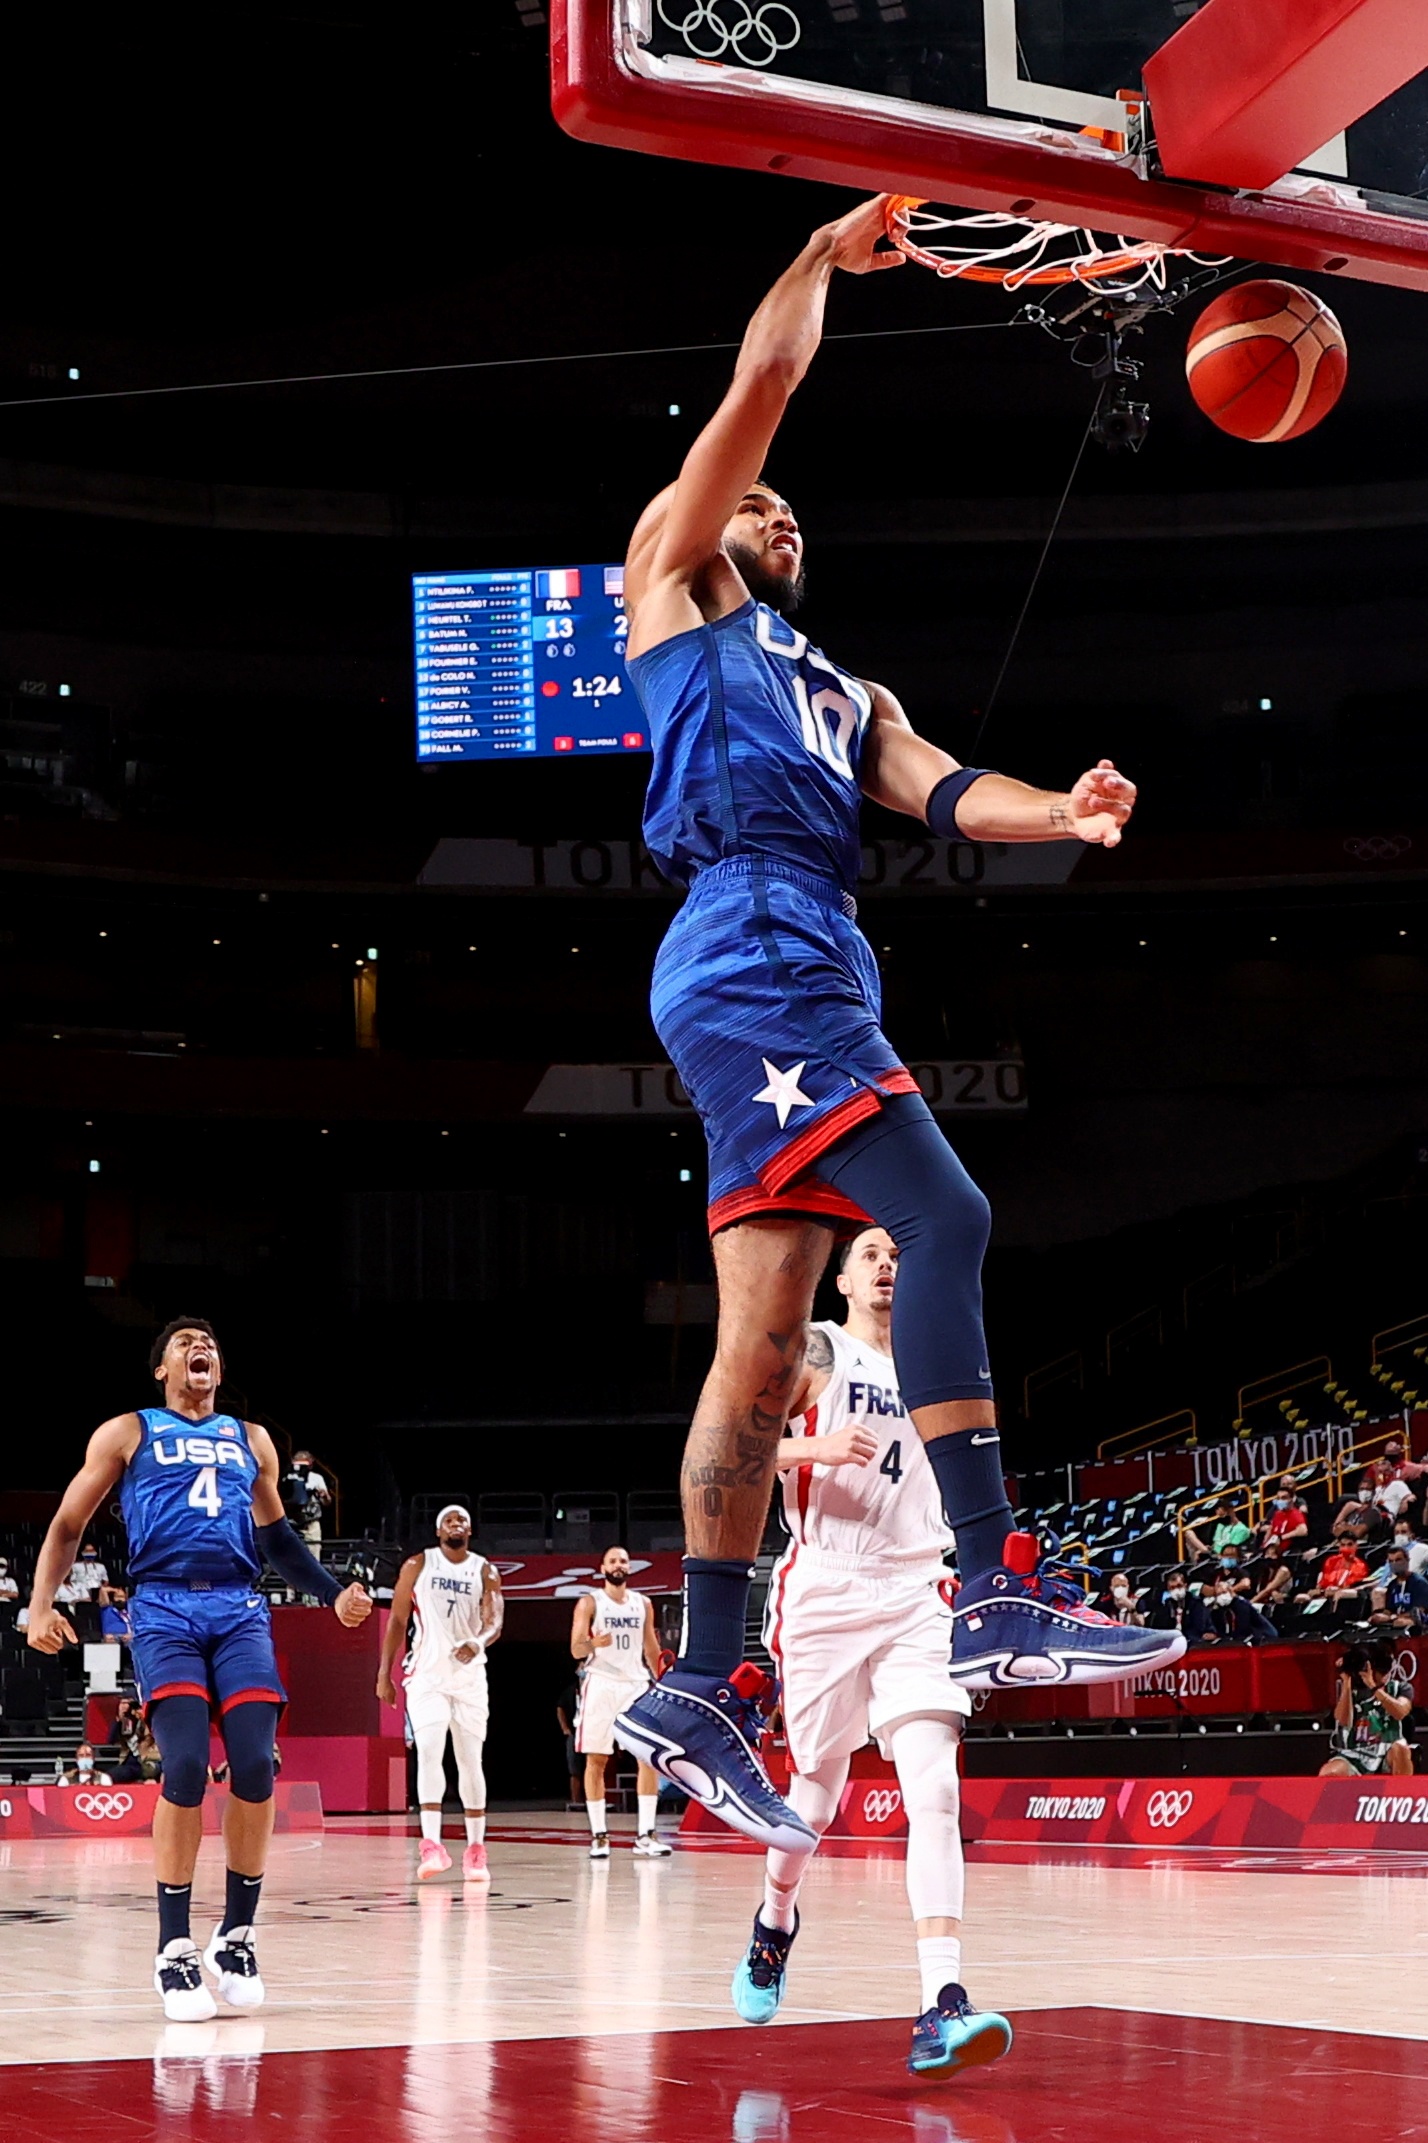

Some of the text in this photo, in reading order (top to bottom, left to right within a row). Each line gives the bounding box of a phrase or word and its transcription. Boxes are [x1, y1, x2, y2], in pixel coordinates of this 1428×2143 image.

[545, 599, 572, 612] FRA
[613, 596, 624, 609] U
[545, 617, 574, 639] 13
[613, 614, 628, 636] 2
[440, 671, 466, 682] COLO
[572, 675, 622, 697] 1:24
[430, 714, 464, 725] GOBERT
[792, 674, 858, 780] 10
[431, 744, 452, 753] FALL
[857, 841, 986, 885] 020
[915, 1064, 1028, 1104] 020
[848, 1382, 905, 1418] FRA
[152, 1438, 247, 1468] USA
[879, 1439, 903, 1484] 4
[1189, 1435, 1279, 1487] TOKYO
[188, 1466, 222, 1518] 4
[431, 1577, 473, 1596] FRANCE
[446, 1599, 456, 1618] 7
[604, 1616, 641, 1629] FRANCE
[615, 1633, 631, 1650] 10
[1178, 1667, 1220, 1697] 2020
[1025, 1796, 1106, 1819] TOKYO 2020
[1354, 1796, 1414, 1823] TOKYO
